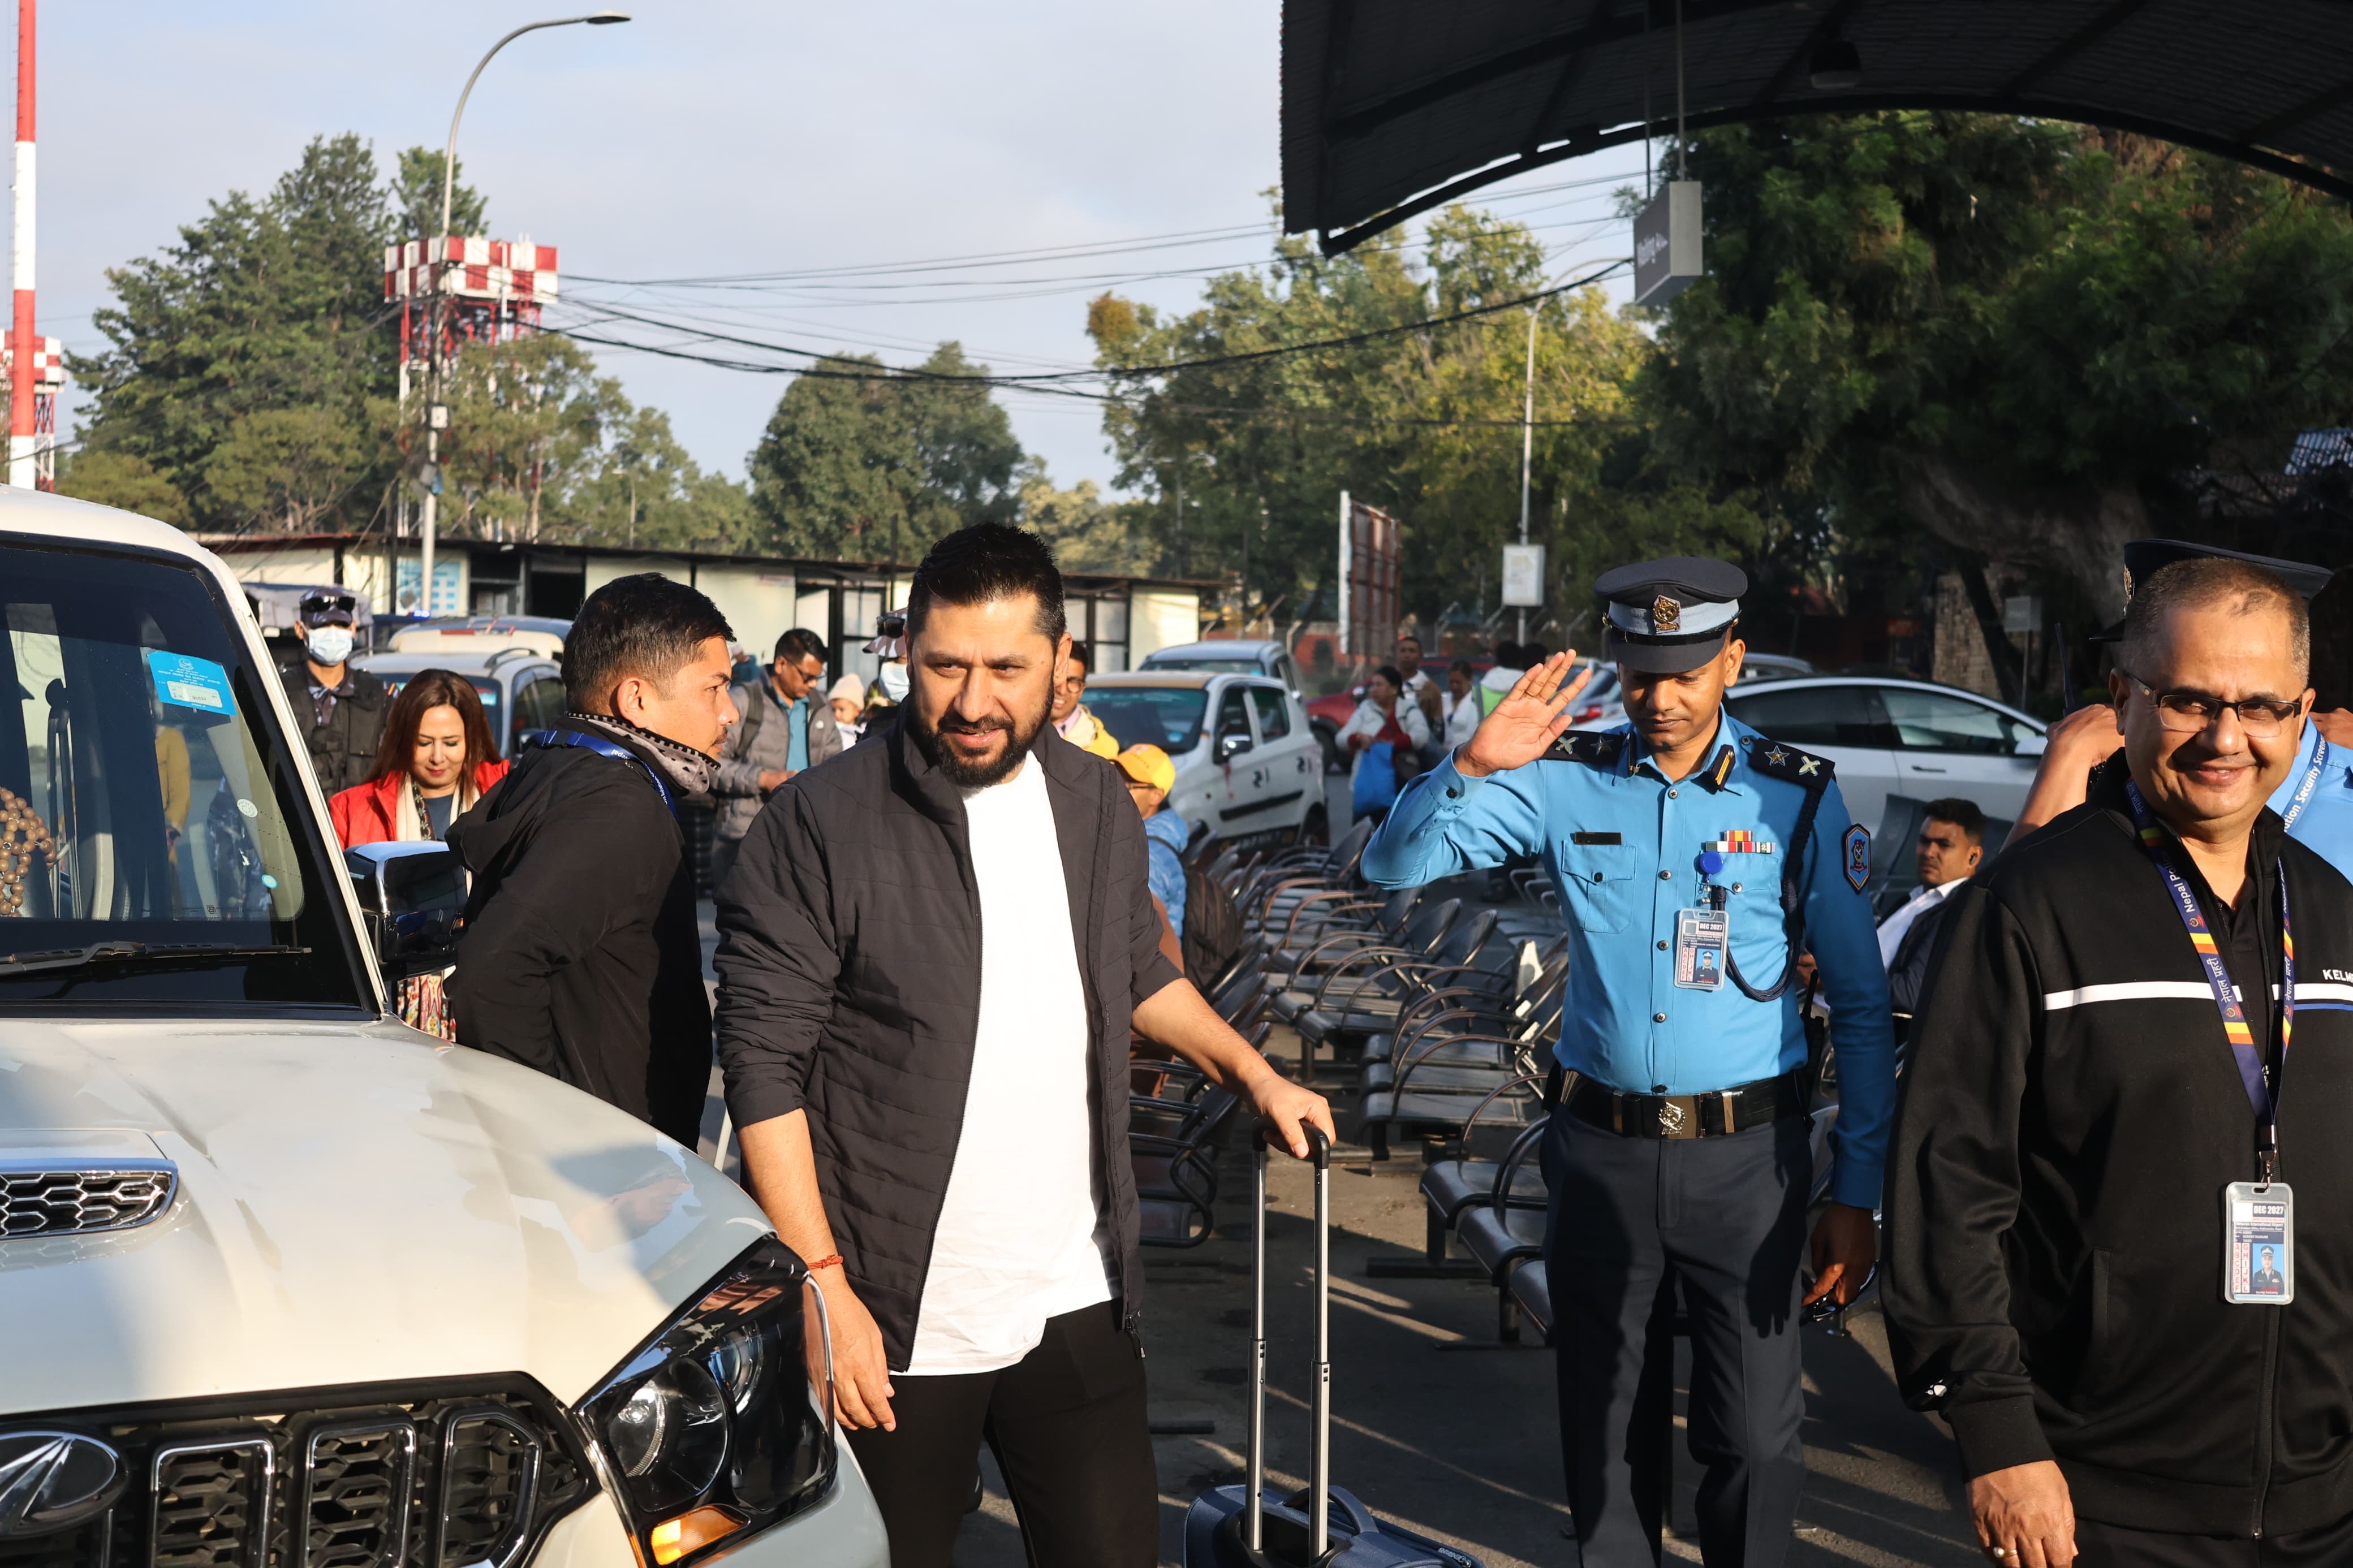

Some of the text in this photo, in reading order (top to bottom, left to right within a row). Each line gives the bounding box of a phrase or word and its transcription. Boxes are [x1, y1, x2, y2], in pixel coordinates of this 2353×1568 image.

[2283, 804, 2301, 832] ation
[2295, 765, 2321, 804] Security
[2174, 883, 2195, 913] Nepal
[2207, 957, 2233, 1004] नेपाल प्रहरी
